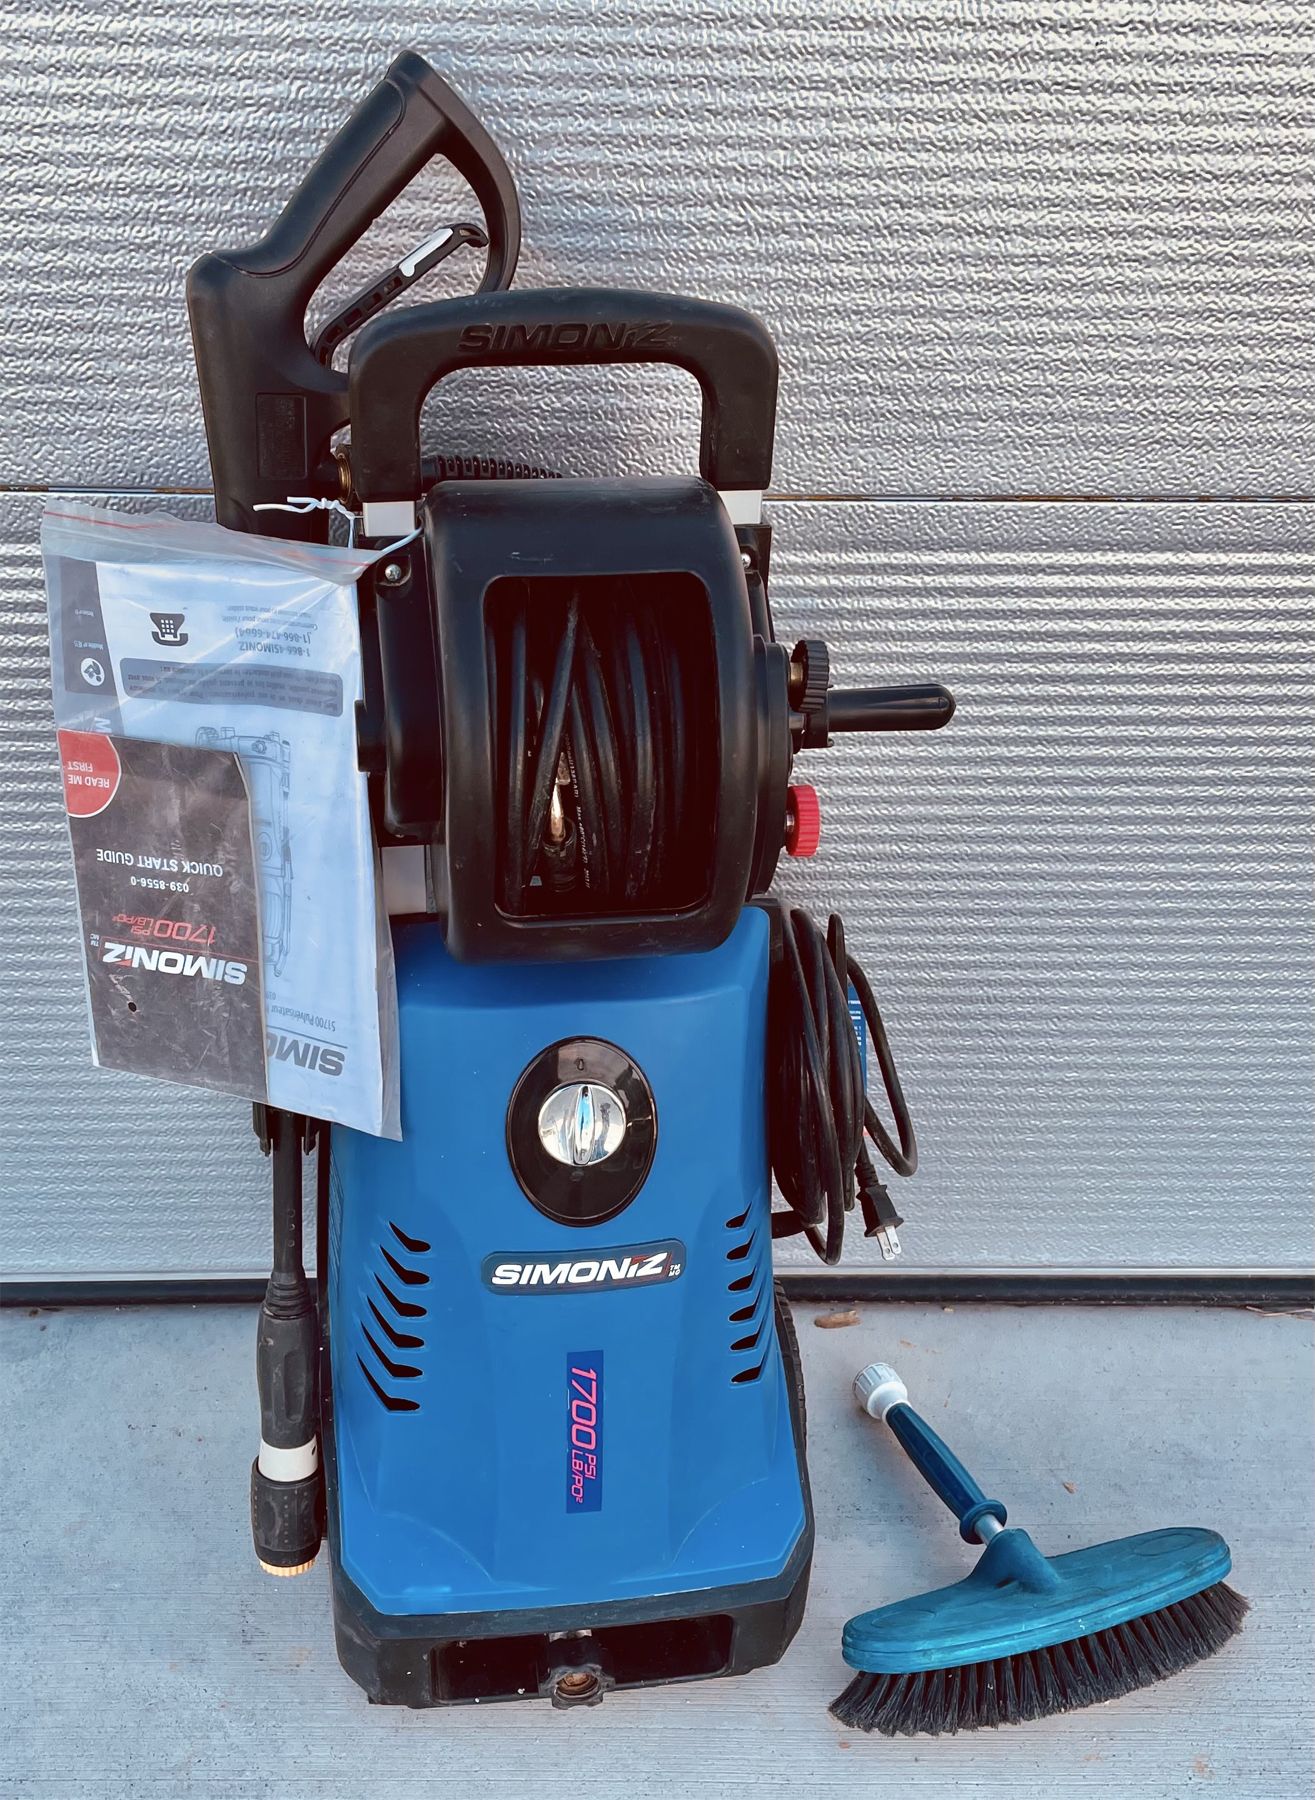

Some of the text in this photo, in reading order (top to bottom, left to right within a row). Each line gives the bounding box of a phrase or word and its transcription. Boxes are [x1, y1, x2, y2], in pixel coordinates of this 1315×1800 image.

[458, 320, 672, 350] SIMONIZ
[67, 761, 93, 773] FIRST
[67, 774, 110, 788] READ ME
[95, 848, 223, 877] QUICK START GUIDE
[130, 875, 189, 893] 039-8556-0
[131, 919, 217, 945] 1700 PSI
[102, 942, 248, 985] SIMONIZ
[491, 1252, 668, 1285] SIMONIZ
[571, 1367, 597, 1479] 1700 PSI
